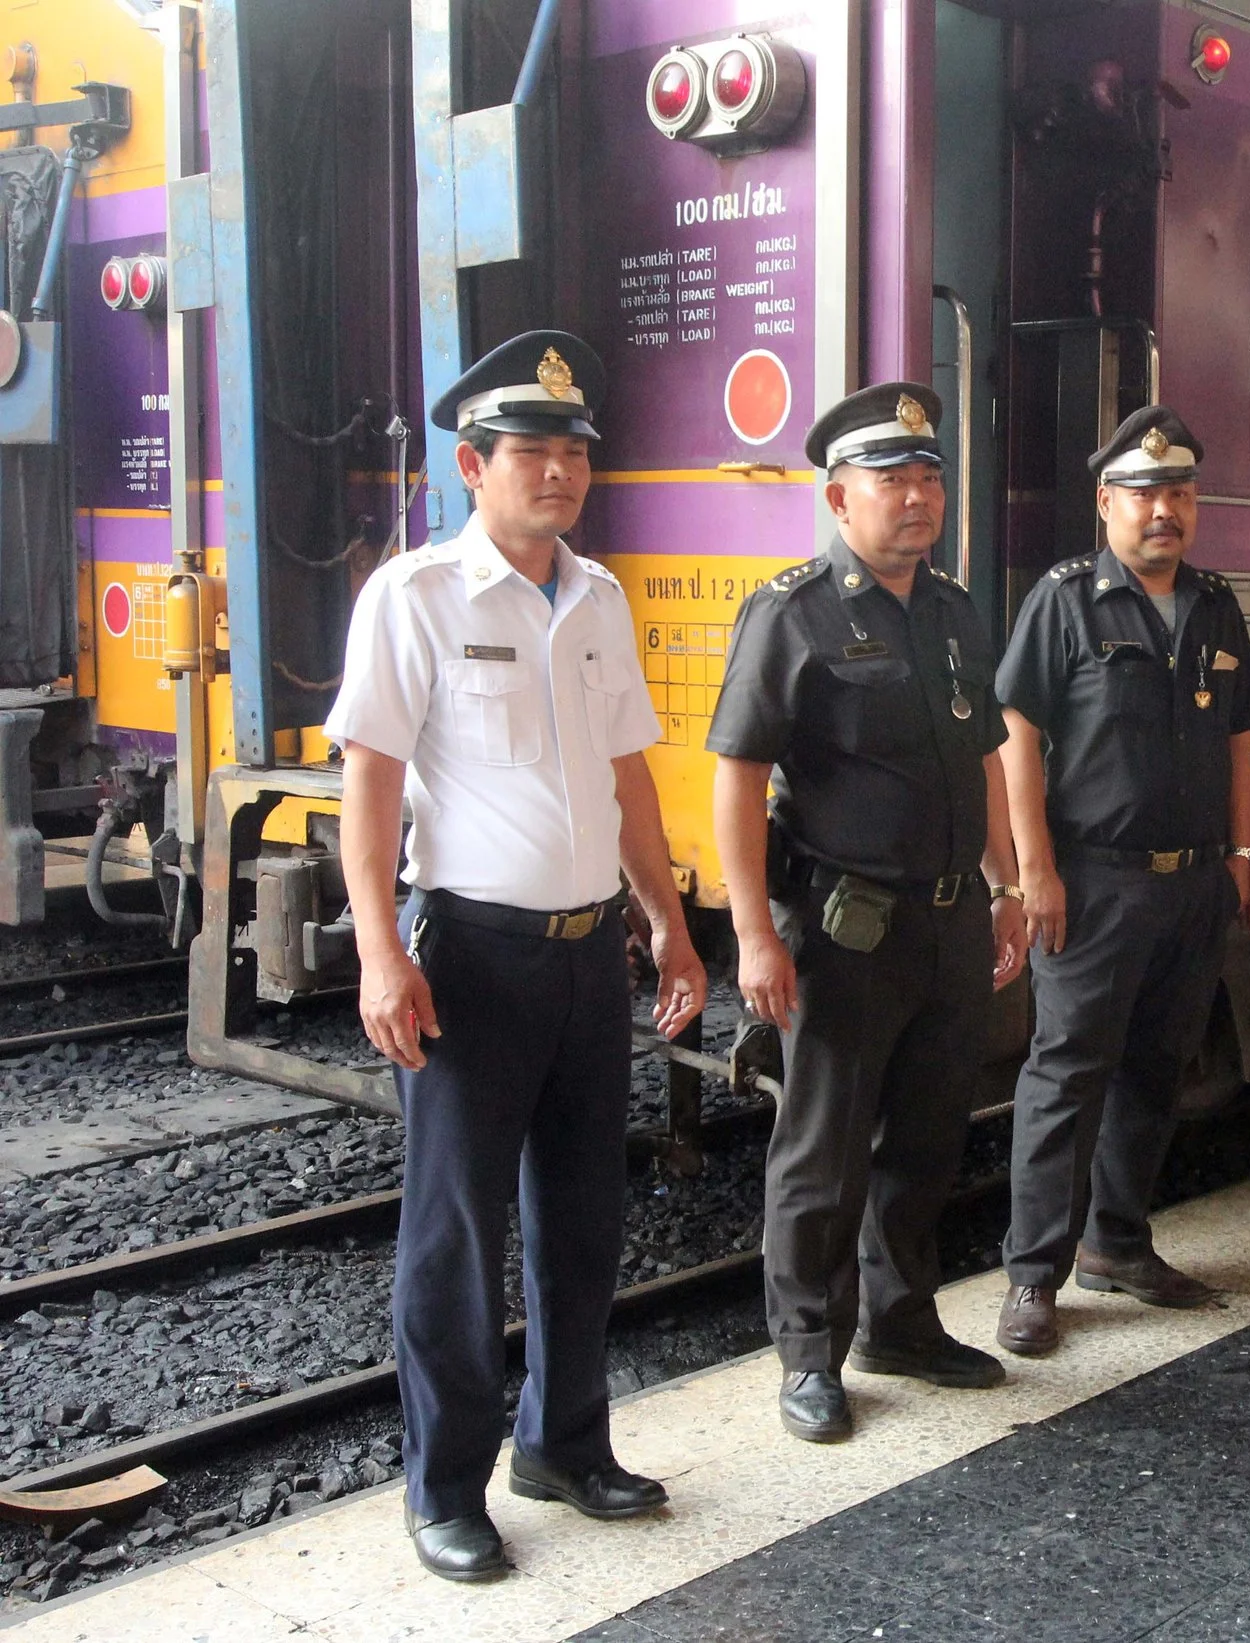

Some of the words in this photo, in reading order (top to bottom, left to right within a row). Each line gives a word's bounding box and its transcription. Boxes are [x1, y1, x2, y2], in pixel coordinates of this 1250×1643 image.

[676, 198, 708, 226] 100
[712, 181, 786, 221] กม./ชม.
[677, 245, 717, 265] (TARE)
[677, 266, 717, 284] (LOAD)
[725, 278, 774, 297] WEIGHT)
[141, 394, 157, 411] 100
[648, 628, 660, 648] 6
